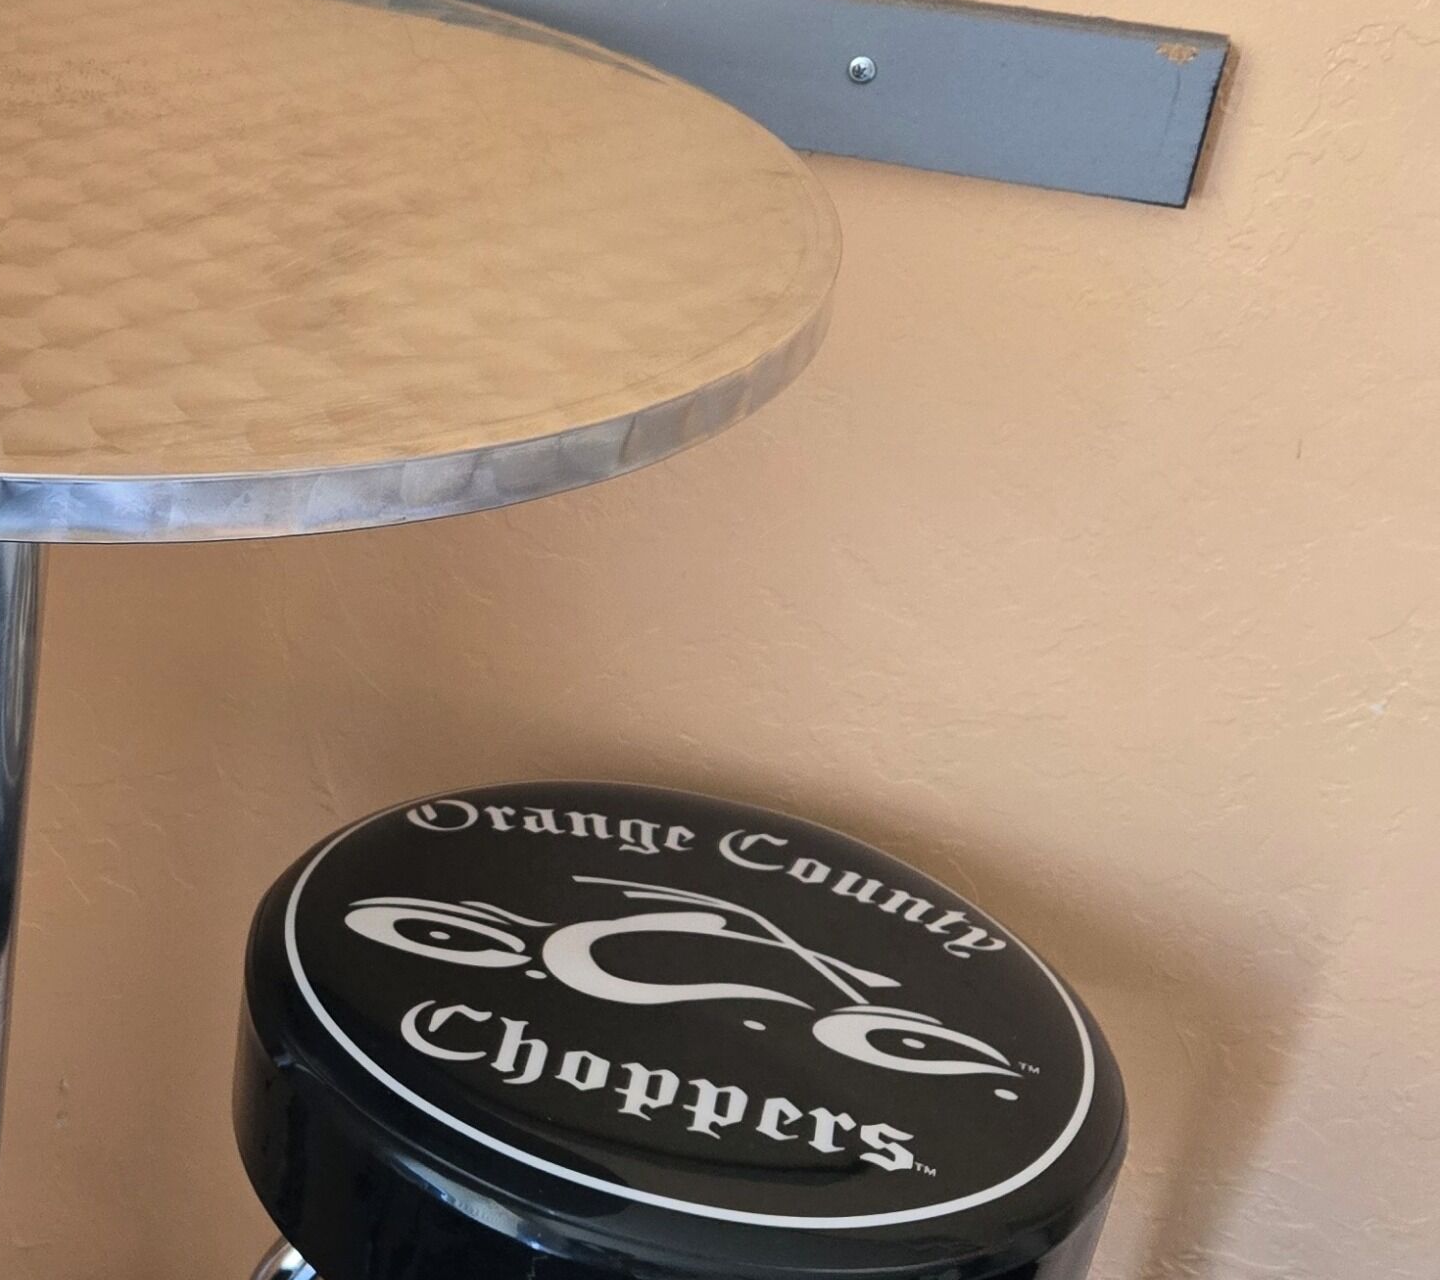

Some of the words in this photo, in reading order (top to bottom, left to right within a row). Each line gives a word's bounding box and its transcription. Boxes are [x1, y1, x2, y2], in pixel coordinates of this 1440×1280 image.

[406, 798, 696, 855] Orange
[717, 828, 1008, 960] County
[399, 999, 915, 1173] Choppers
